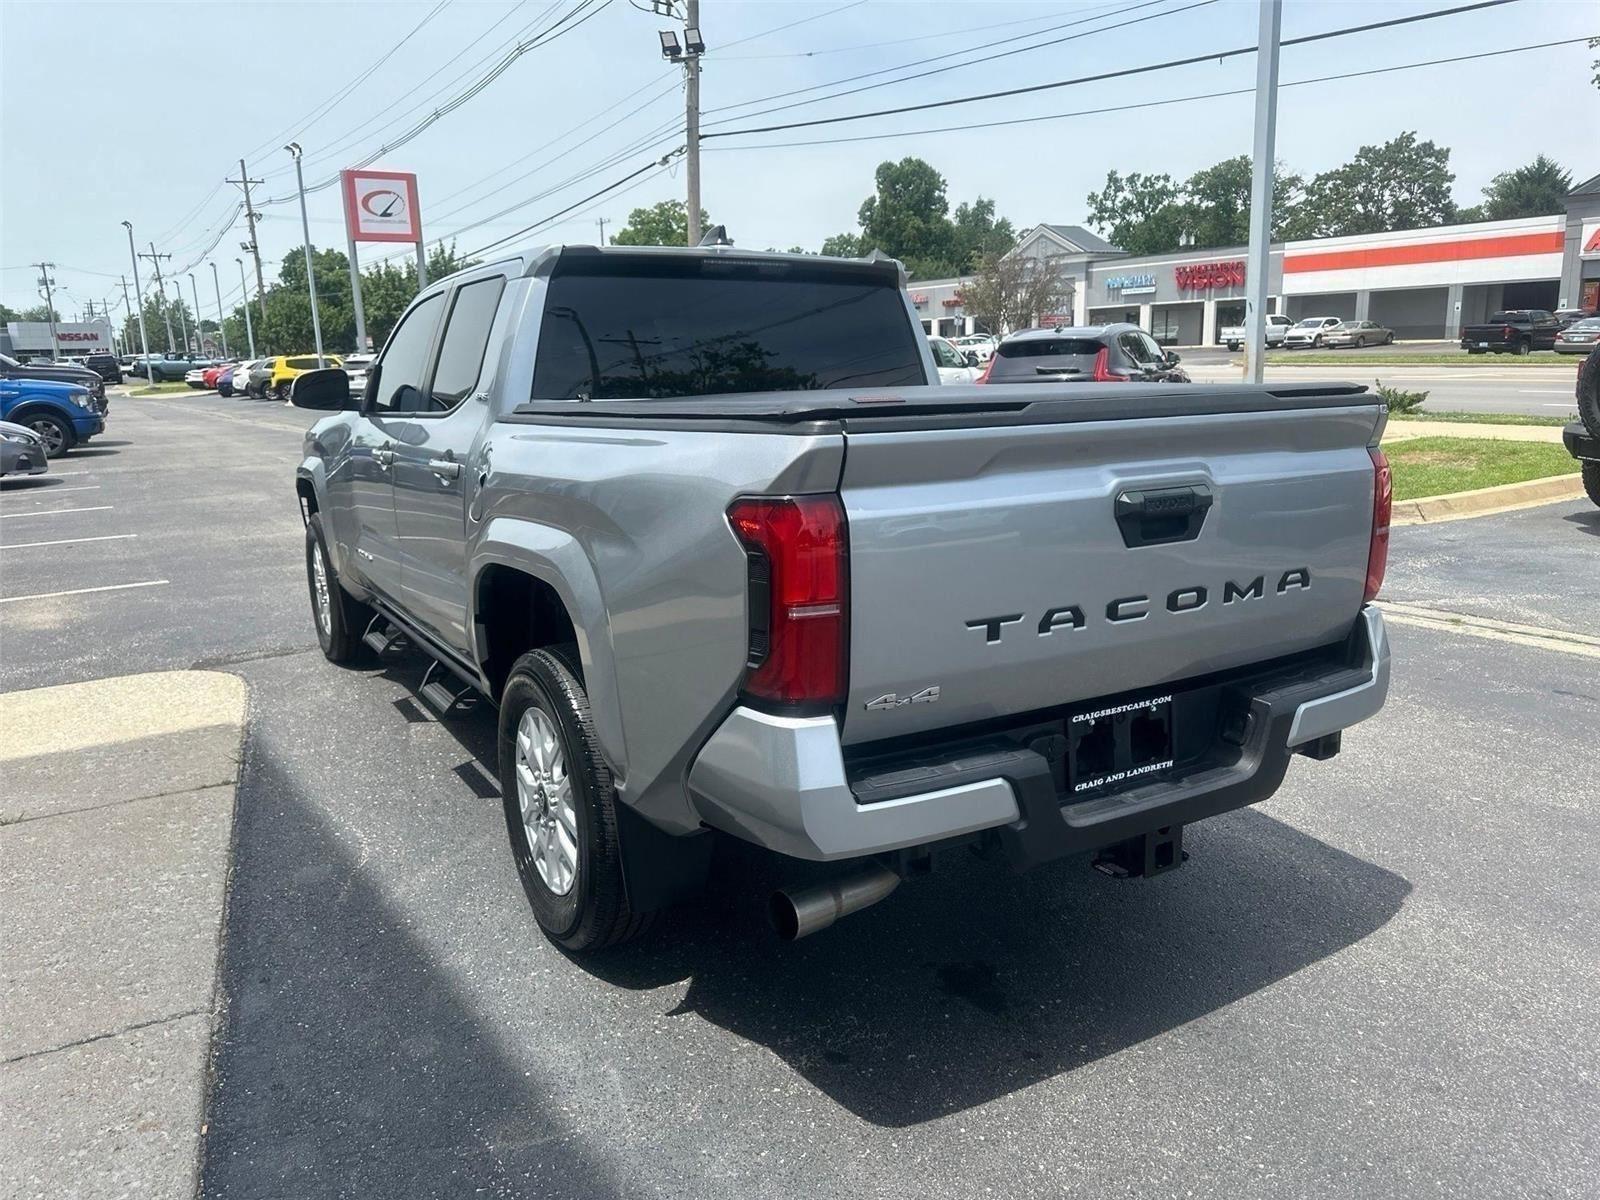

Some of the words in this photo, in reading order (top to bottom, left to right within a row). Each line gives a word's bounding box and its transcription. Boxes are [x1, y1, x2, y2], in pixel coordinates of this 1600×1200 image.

[1176, 272, 1246, 290] VISION
[56, 332, 99, 341] NISSAN
[965, 567, 1311, 644] TACOMA
[1072, 695, 1172, 723] CRAIGSBESTCARS.COM
[1075, 778, 1104, 791] CRAIG
[1105, 772, 1125, 783] AND
[1126, 760, 1174, 777] LANDRETH
